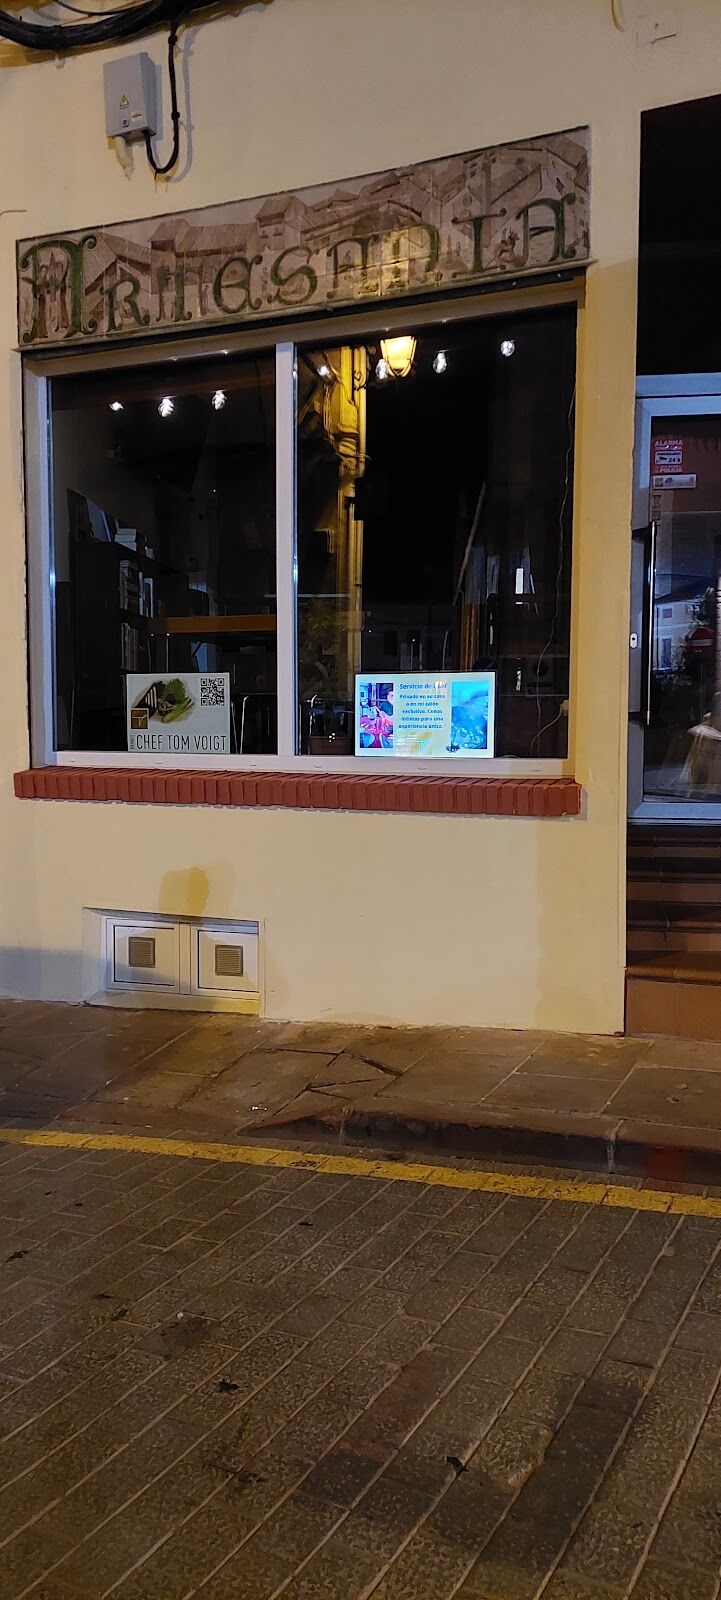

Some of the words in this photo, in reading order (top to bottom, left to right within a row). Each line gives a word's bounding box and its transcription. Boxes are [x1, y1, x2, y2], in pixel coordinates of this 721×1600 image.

[136, 734, 163, 750] CHEF
[167, 735, 190, 750] TOM
[194, 735, 227, 751] VOIGT
